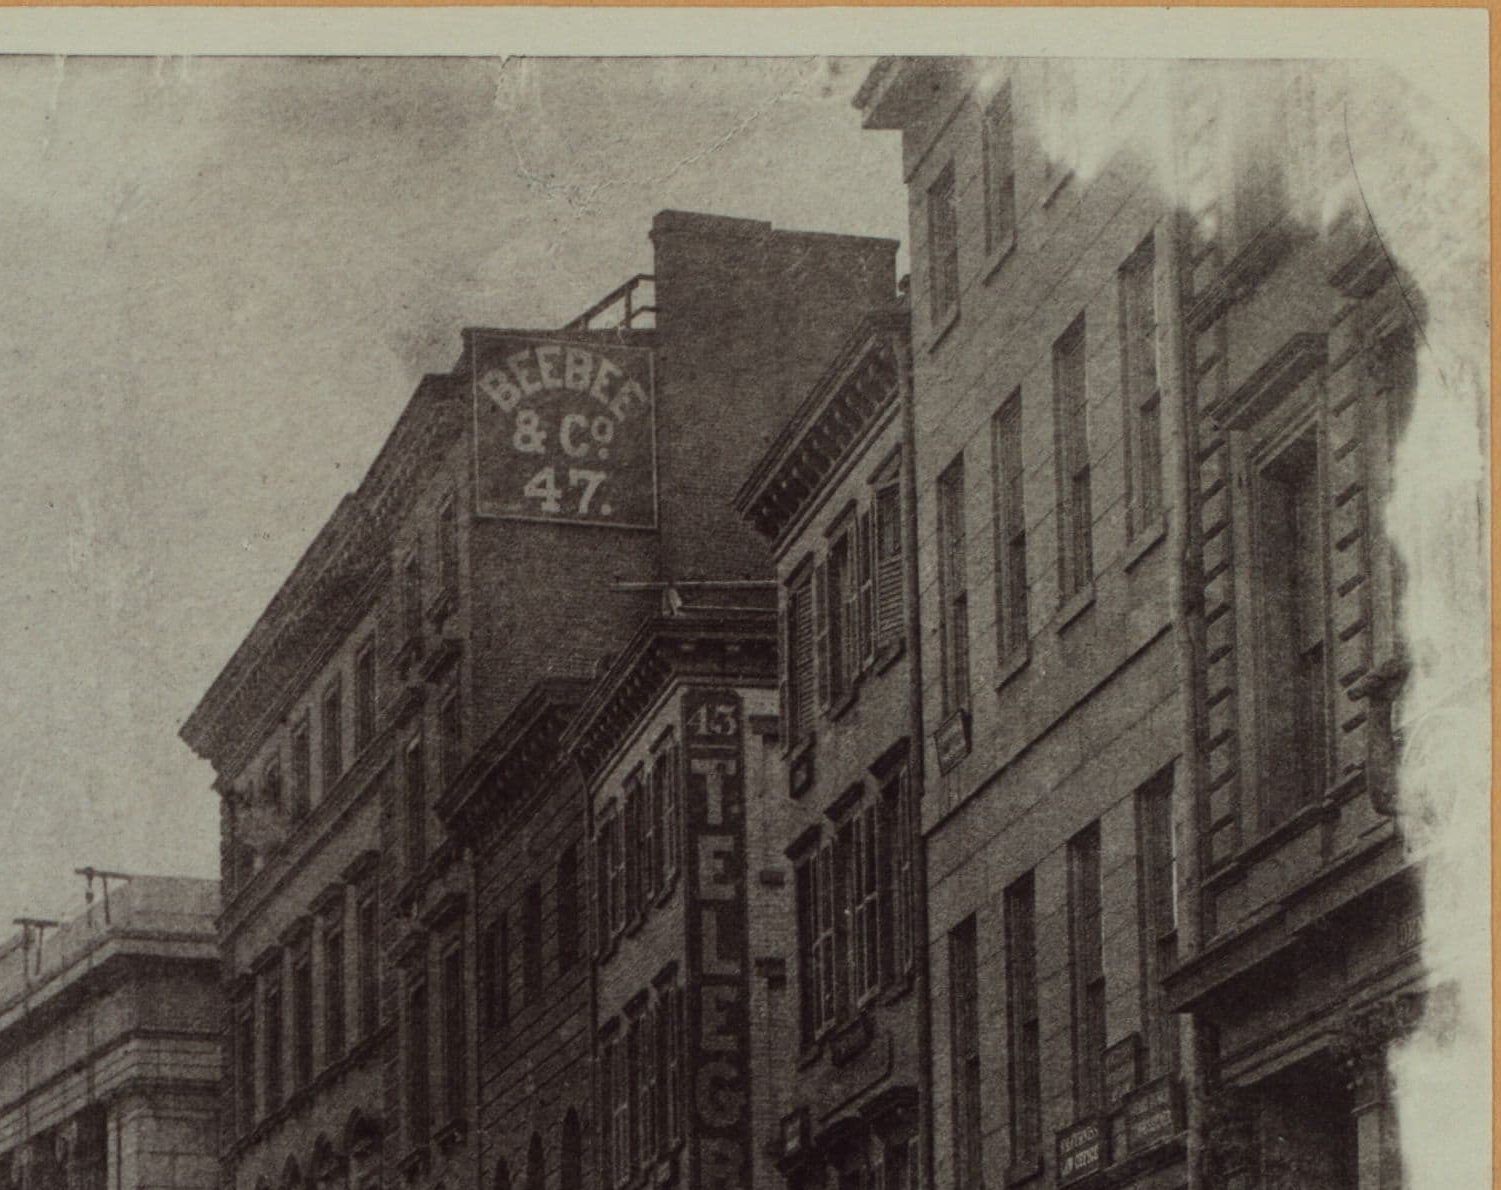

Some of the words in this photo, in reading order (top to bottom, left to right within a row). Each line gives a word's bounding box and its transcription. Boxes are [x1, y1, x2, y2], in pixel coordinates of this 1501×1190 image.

[478, 346, 648, 421] BEEBEE
[513, 410, 547, 454] &
[523, 467, 613, 515] 47.
[687, 703, 737, 736] 45
